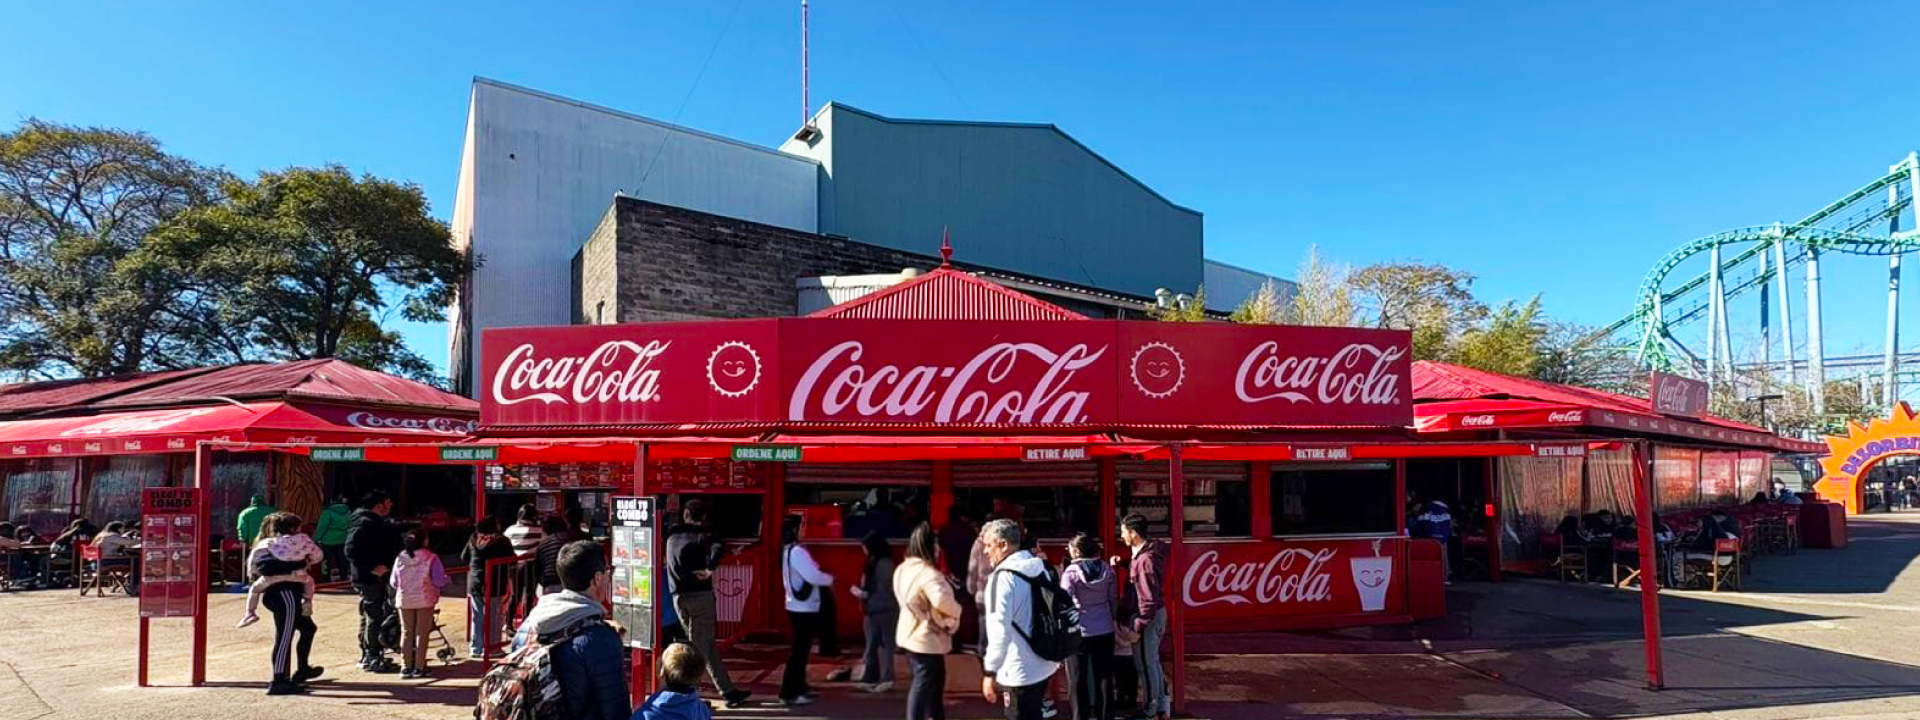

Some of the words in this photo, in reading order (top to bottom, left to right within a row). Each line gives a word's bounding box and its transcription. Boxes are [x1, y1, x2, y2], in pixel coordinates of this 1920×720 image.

[492, 340, 673, 405] Coca-Cola
[788, 340, 1109, 424] Coca-Cola
[1234, 340, 1408, 405] Coca-Cola
[1461, 414, 1496, 427] Coca-Cola
[1548, 410, 1583, 423] Coca-Cola
[736, 448, 773, 459] ORDENE
[1027, 448, 1060, 460] RETIRE
[1296, 448, 1326, 459] RETIRE
[1840, 436, 1920, 476] DESORBI
[1182, 547, 1338, 607] Coca-Cola
